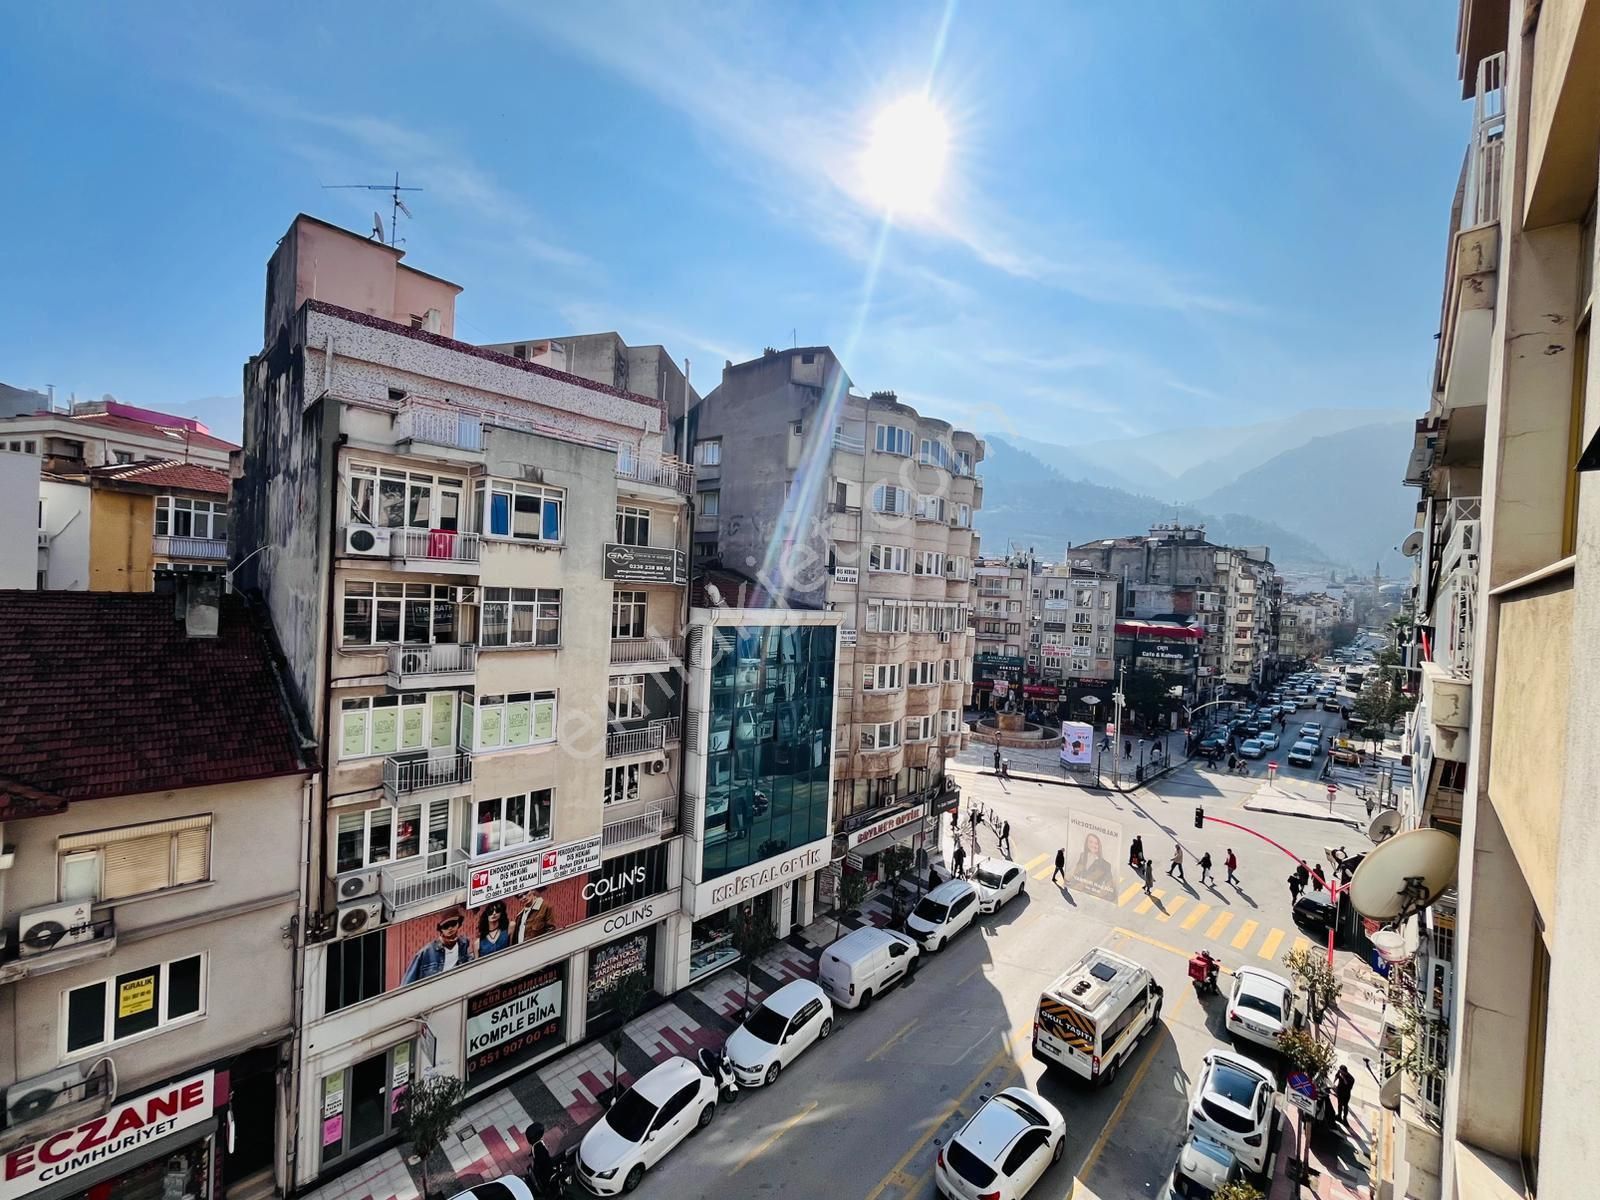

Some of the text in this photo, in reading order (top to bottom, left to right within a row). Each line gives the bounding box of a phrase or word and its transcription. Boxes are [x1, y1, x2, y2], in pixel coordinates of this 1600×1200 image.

[499, 871, 509, 881] DİŞ
[582, 865, 646, 900] COLIN'S
[713, 866, 779, 904] KRİSTAL
[780, 849, 820, 876] OPTİK
[604, 904, 653, 933] COLIN'S
[470, 1003, 555, 1052] KOMPLE BİNA
[491, 993, 539, 1025] SATILIK
[1041, 1010, 1093, 1042] OKUL TAŞITI
[480, 1050, 499, 1067] 551
[503, 1039, 523, 1056] 907
[526, 1031, 540, 1044] 00
[543, 1023, 557, 1035] 45
[5, 1079, 204, 1181] ECZANE
[38, 1116, 178, 1182] CUMHURİYET
